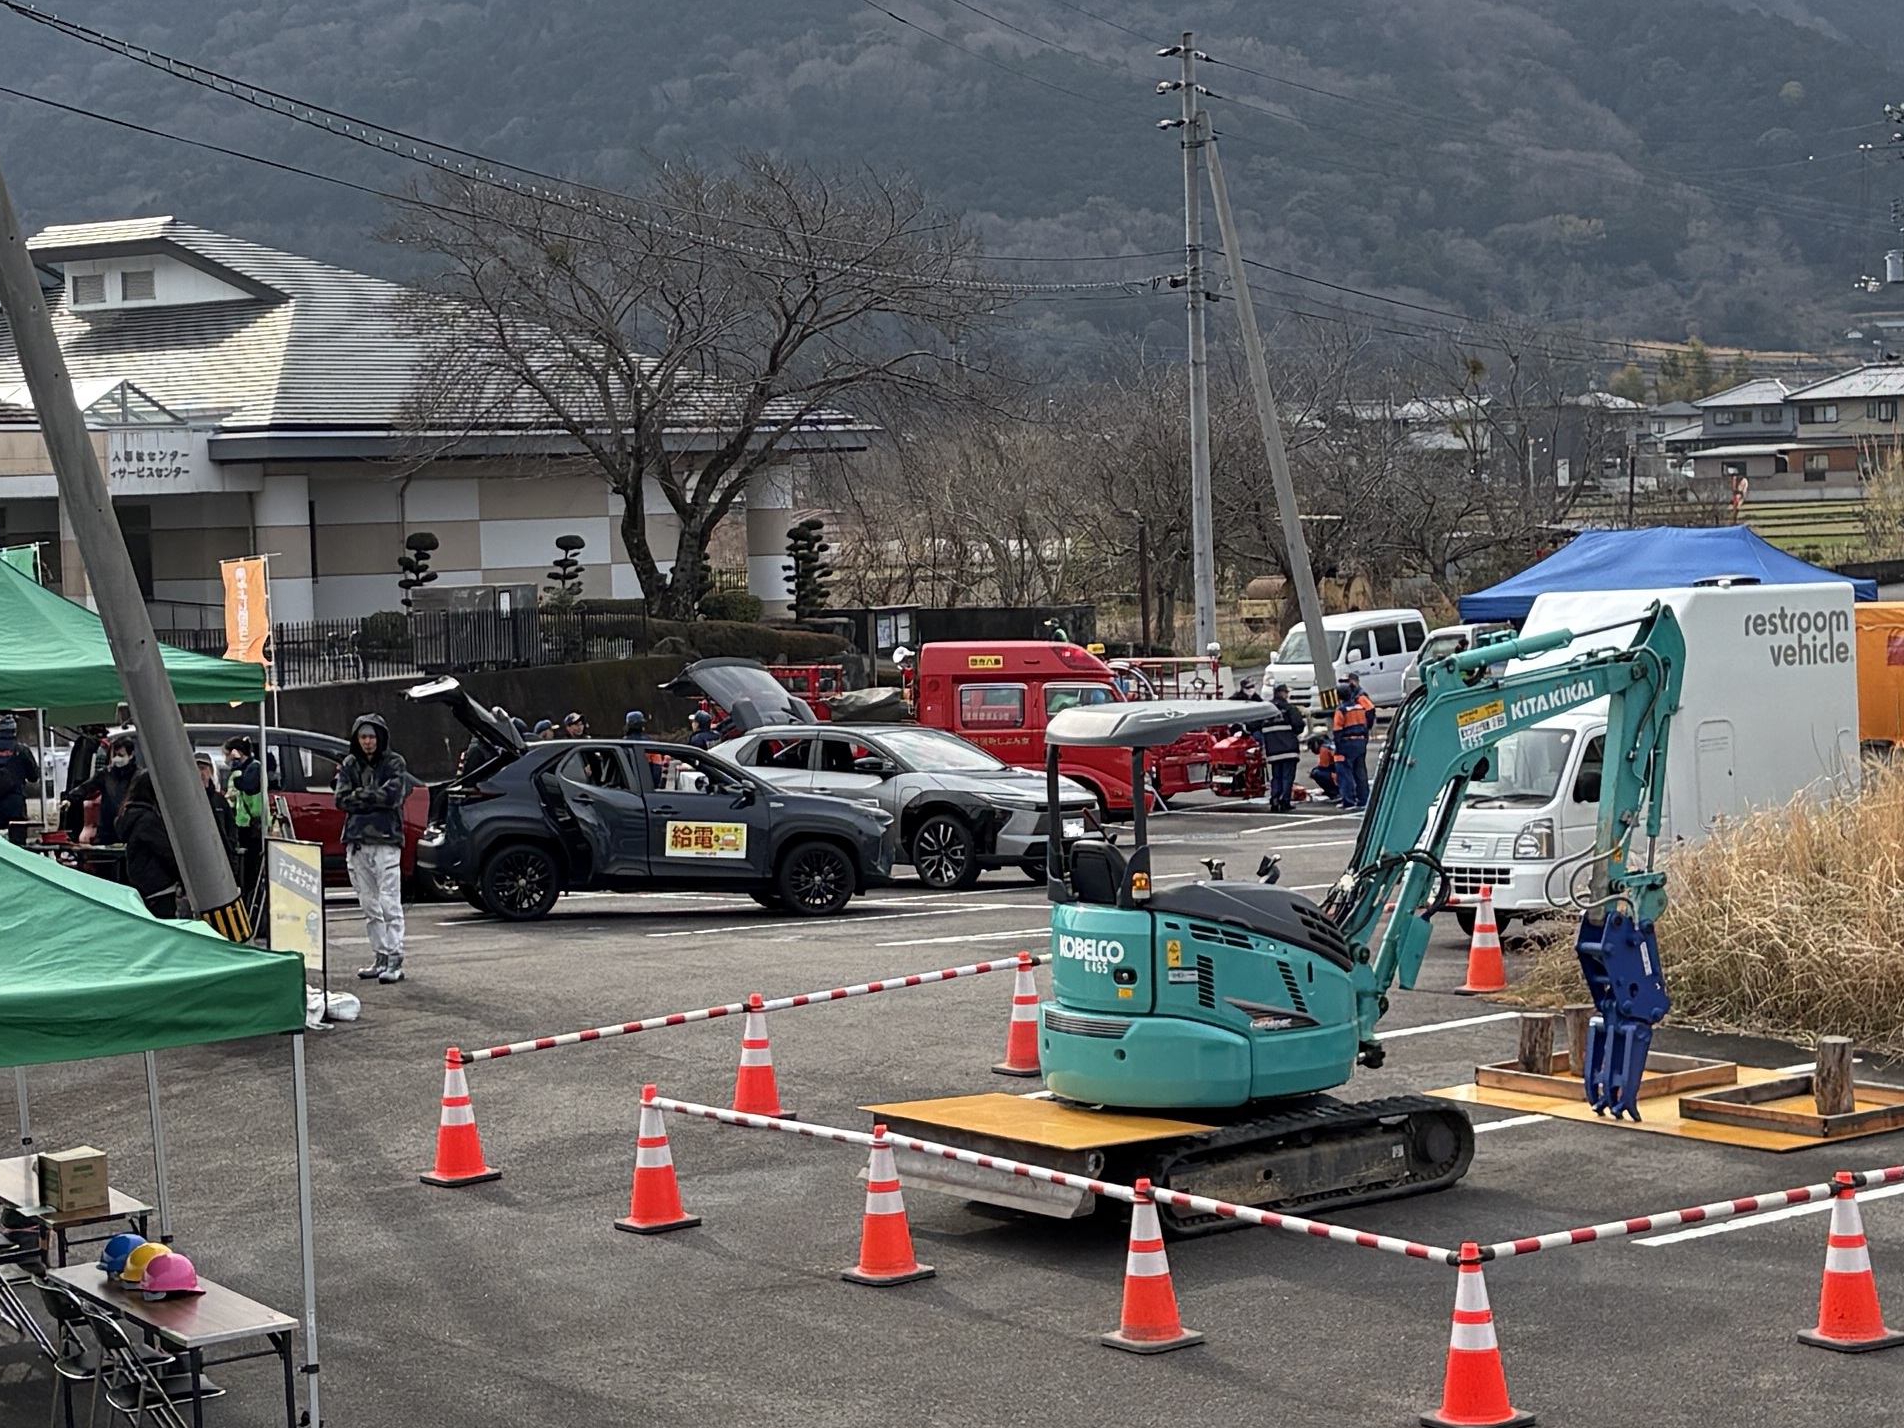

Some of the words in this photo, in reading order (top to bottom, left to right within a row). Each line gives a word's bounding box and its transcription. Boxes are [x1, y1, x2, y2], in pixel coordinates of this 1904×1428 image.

[1744, 606, 1848, 636] restroom
[1770, 633, 1849, 667] vehicle
[671, 826, 713, 849] 給電
[1059, 934, 1124, 964] KOBELCO
